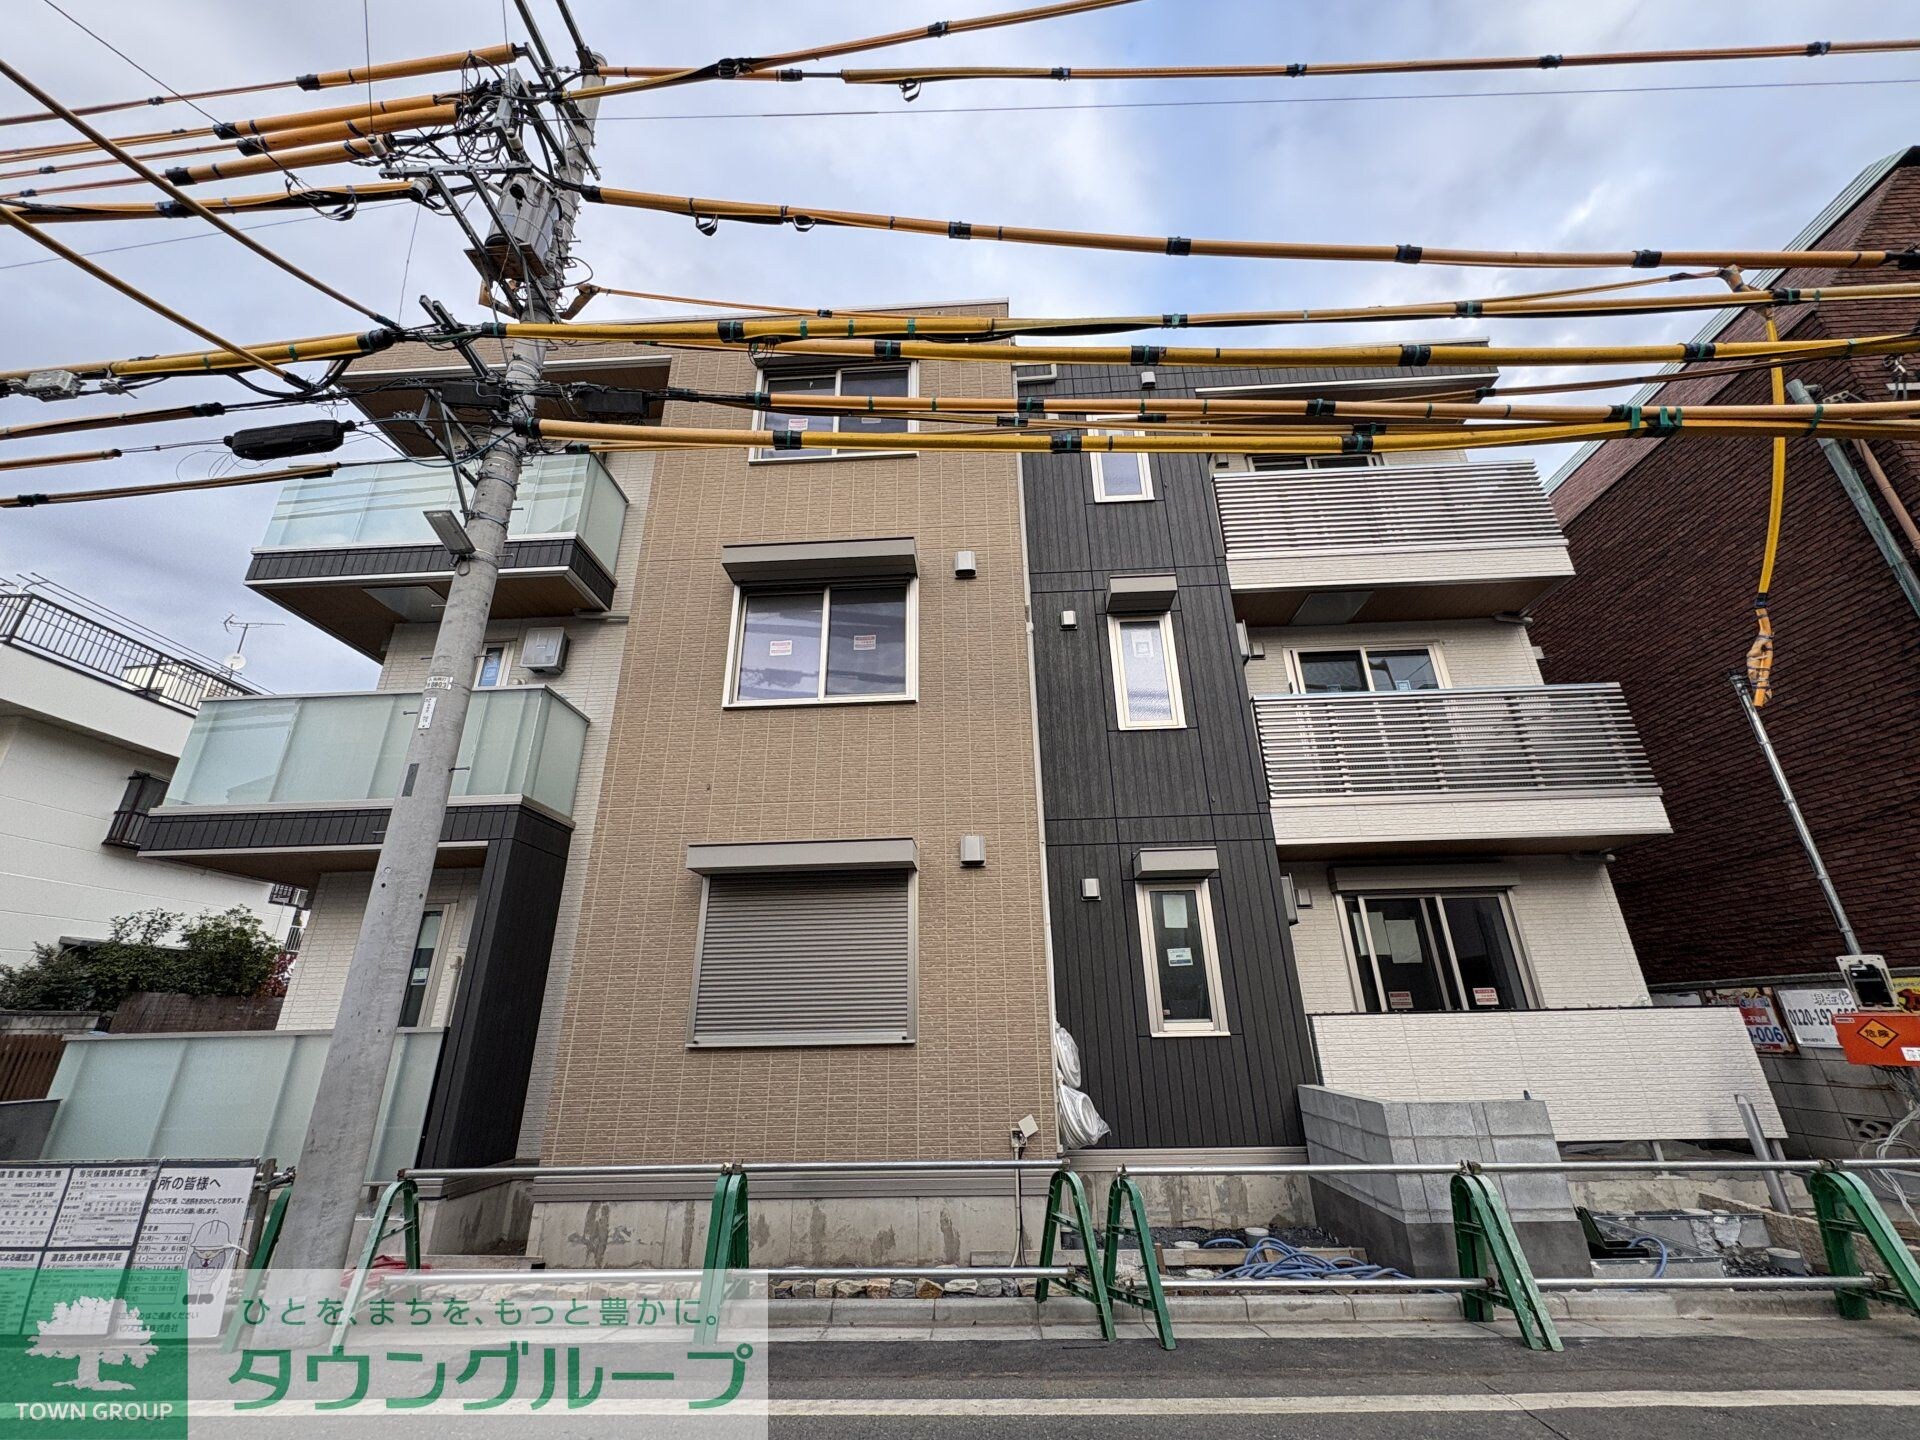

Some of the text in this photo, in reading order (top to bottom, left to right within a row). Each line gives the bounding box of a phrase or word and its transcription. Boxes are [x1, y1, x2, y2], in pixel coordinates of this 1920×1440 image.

[1864, 1029, 1890, 1038] 危険
[153, 1176, 221, 1191] 所の皆様へ
